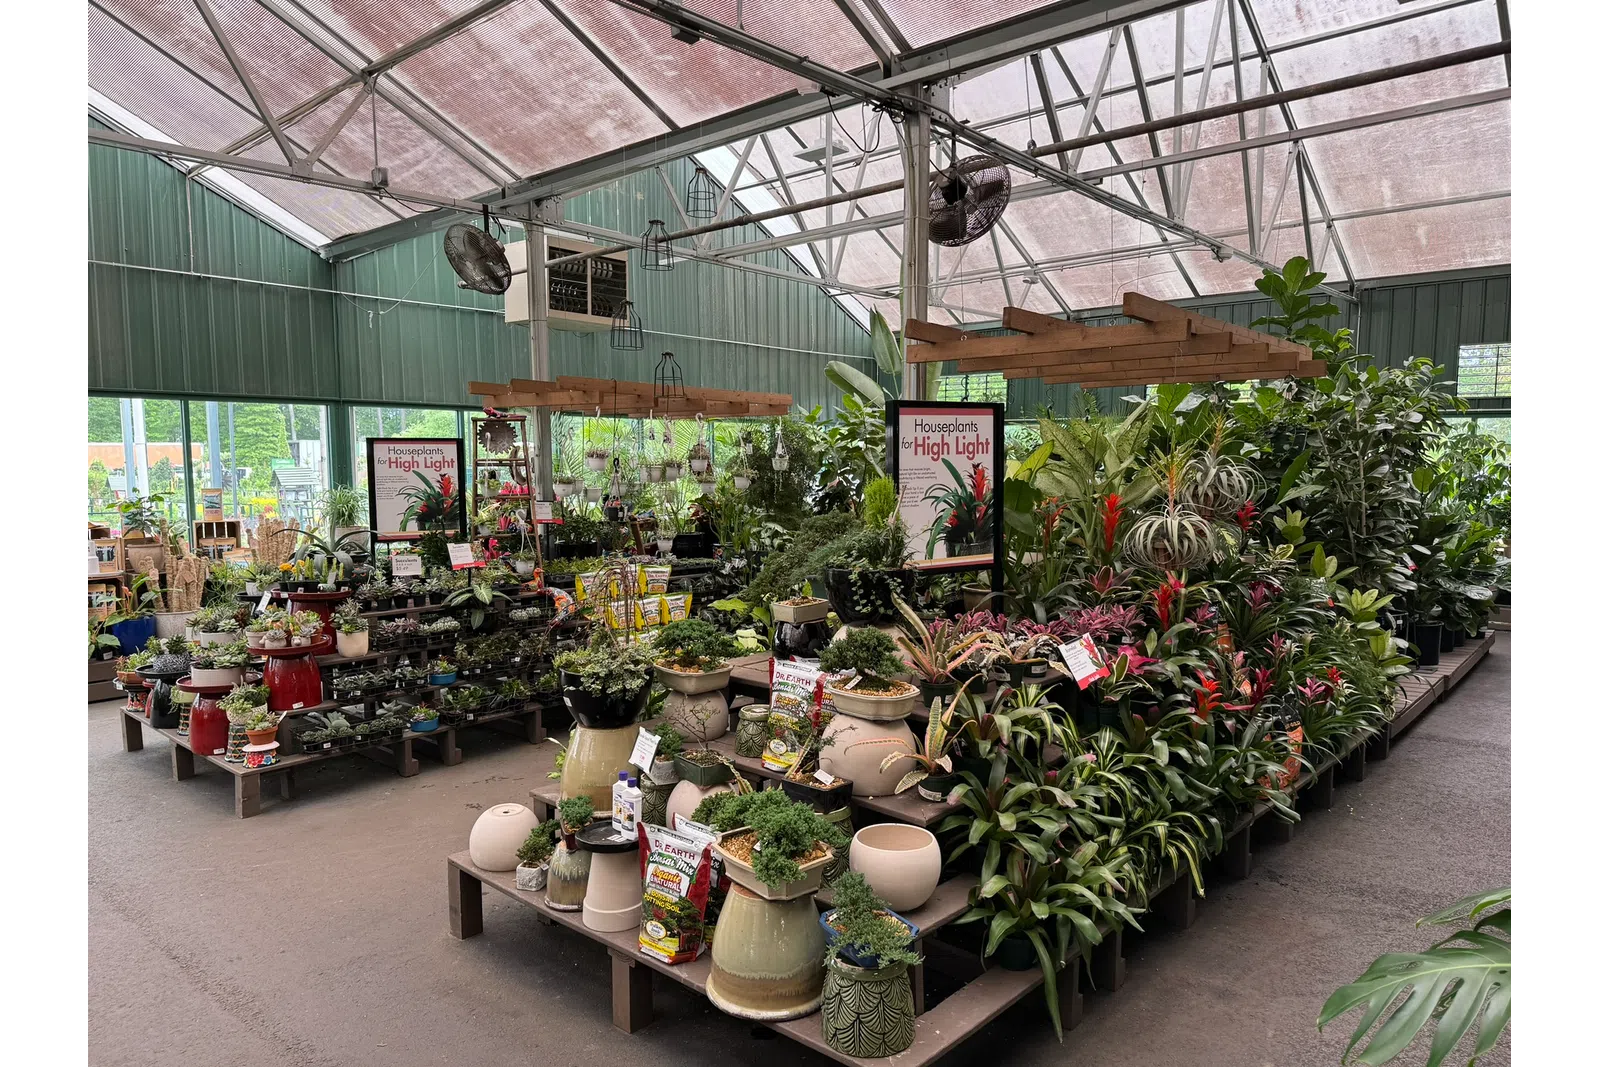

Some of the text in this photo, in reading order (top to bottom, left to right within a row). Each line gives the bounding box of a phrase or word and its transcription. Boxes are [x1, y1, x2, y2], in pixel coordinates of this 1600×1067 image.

[914, 417, 978, 437] Houseplants
[387, 446, 444, 458] Houseplants
[901, 433, 990, 462] for High Light
[388, 456, 419, 472] High
[424, 456, 455, 472] Light
[785, 673, 811, 686] EARTH
[664, 844, 695, 861] EARTH
[649, 850, 695, 876] Bonsai Mix
[644, 893, 665, 908] POTTING
[665, 902, 681, 914] SOIL
